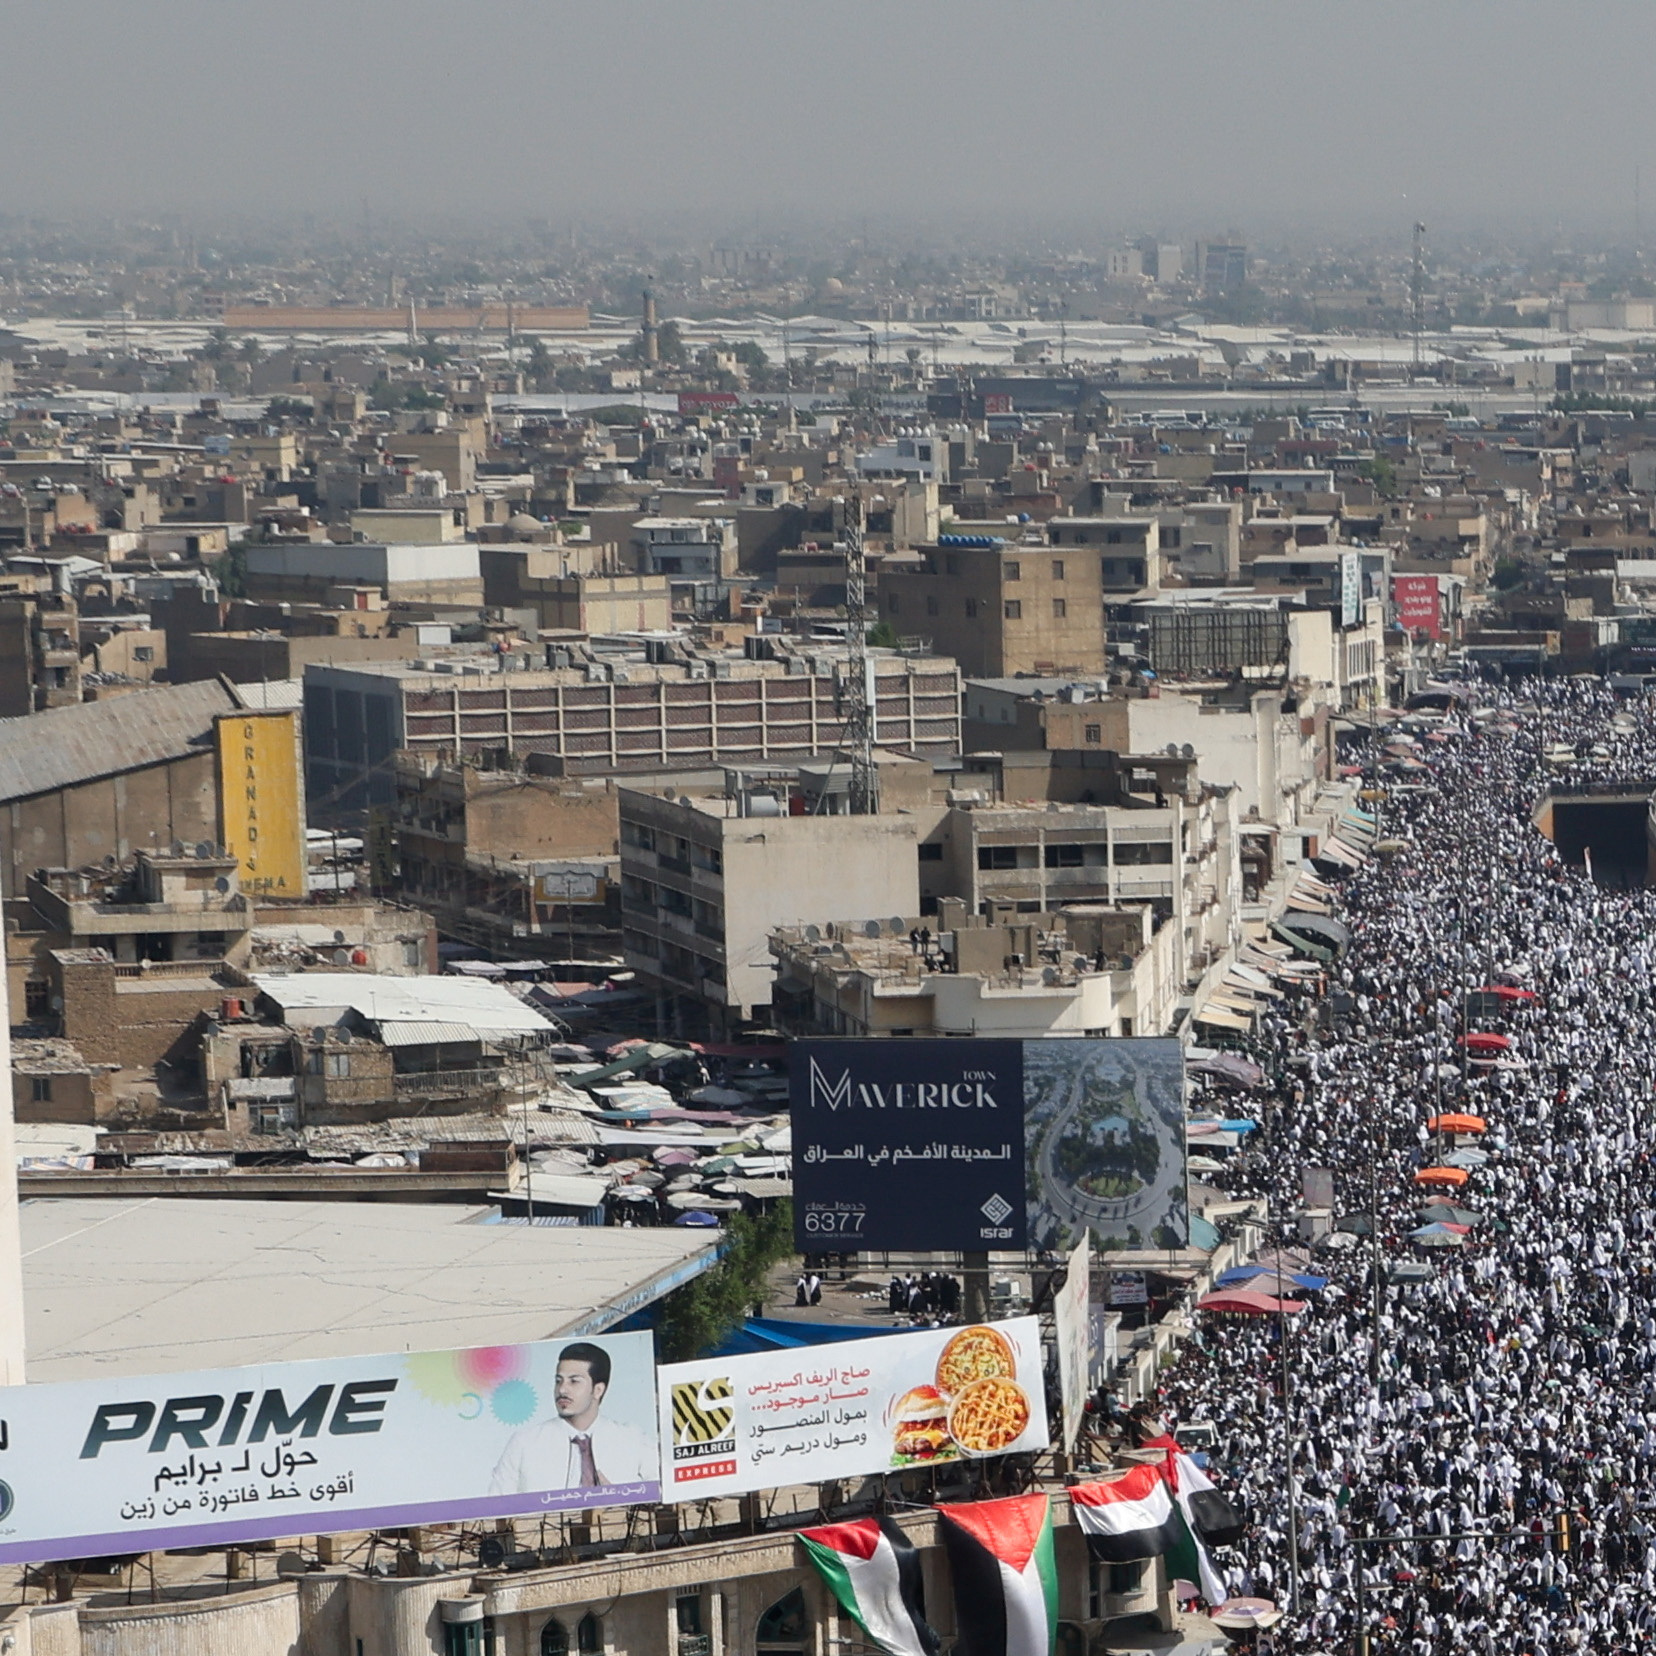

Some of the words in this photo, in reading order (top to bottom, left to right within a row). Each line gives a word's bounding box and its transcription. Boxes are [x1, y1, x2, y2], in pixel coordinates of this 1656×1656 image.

[810, 1055, 998, 1110] MAVERICK
[963, 1070, 996, 1081] TOWN
[803, 1144, 864, 1164] العراق
[868, 1145, 889, 1167] في
[893, 1142, 948, 1165] الأفخم
[950, 1144, 1011, 1161] المدينة
[805, 1213, 865, 1232] 6377
[748, 1371, 803, 1395] اكسبريس
[806, 1367, 837, 1388] الريف
[841, 1366, 871, 1385] صاج
[824, 1386, 869, 1405] صار
[79, 1378, 399, 1459] PRIME
[749, 1410, 830, 1438] المنصور
[834, 1407, 867, 1424] بمول
[675, 1447, 695, 1458] SAJ
[697, 1442, 735, 1456] ALREEF
[780, 1437, 819, 1457] دريم
[824, 1432, 867, 1450] ومول
[751, 1443, 775, 1466] ستي
[154, 1453, 222, 1492] برايم
[677, 1462, 734, 1480] EXPRESS
[267, 1479, 301, 1500] خط
[310, 1470, 355, 1502] أقوى
[584, 1486, 616, 1502] عالم
[163, 1496, 191, 1517] من
[199, 1486, 260, 1515] فاتورة
[541, 1490, 582, 1504] جميل
[120, 1497, 155, 1519] زين
